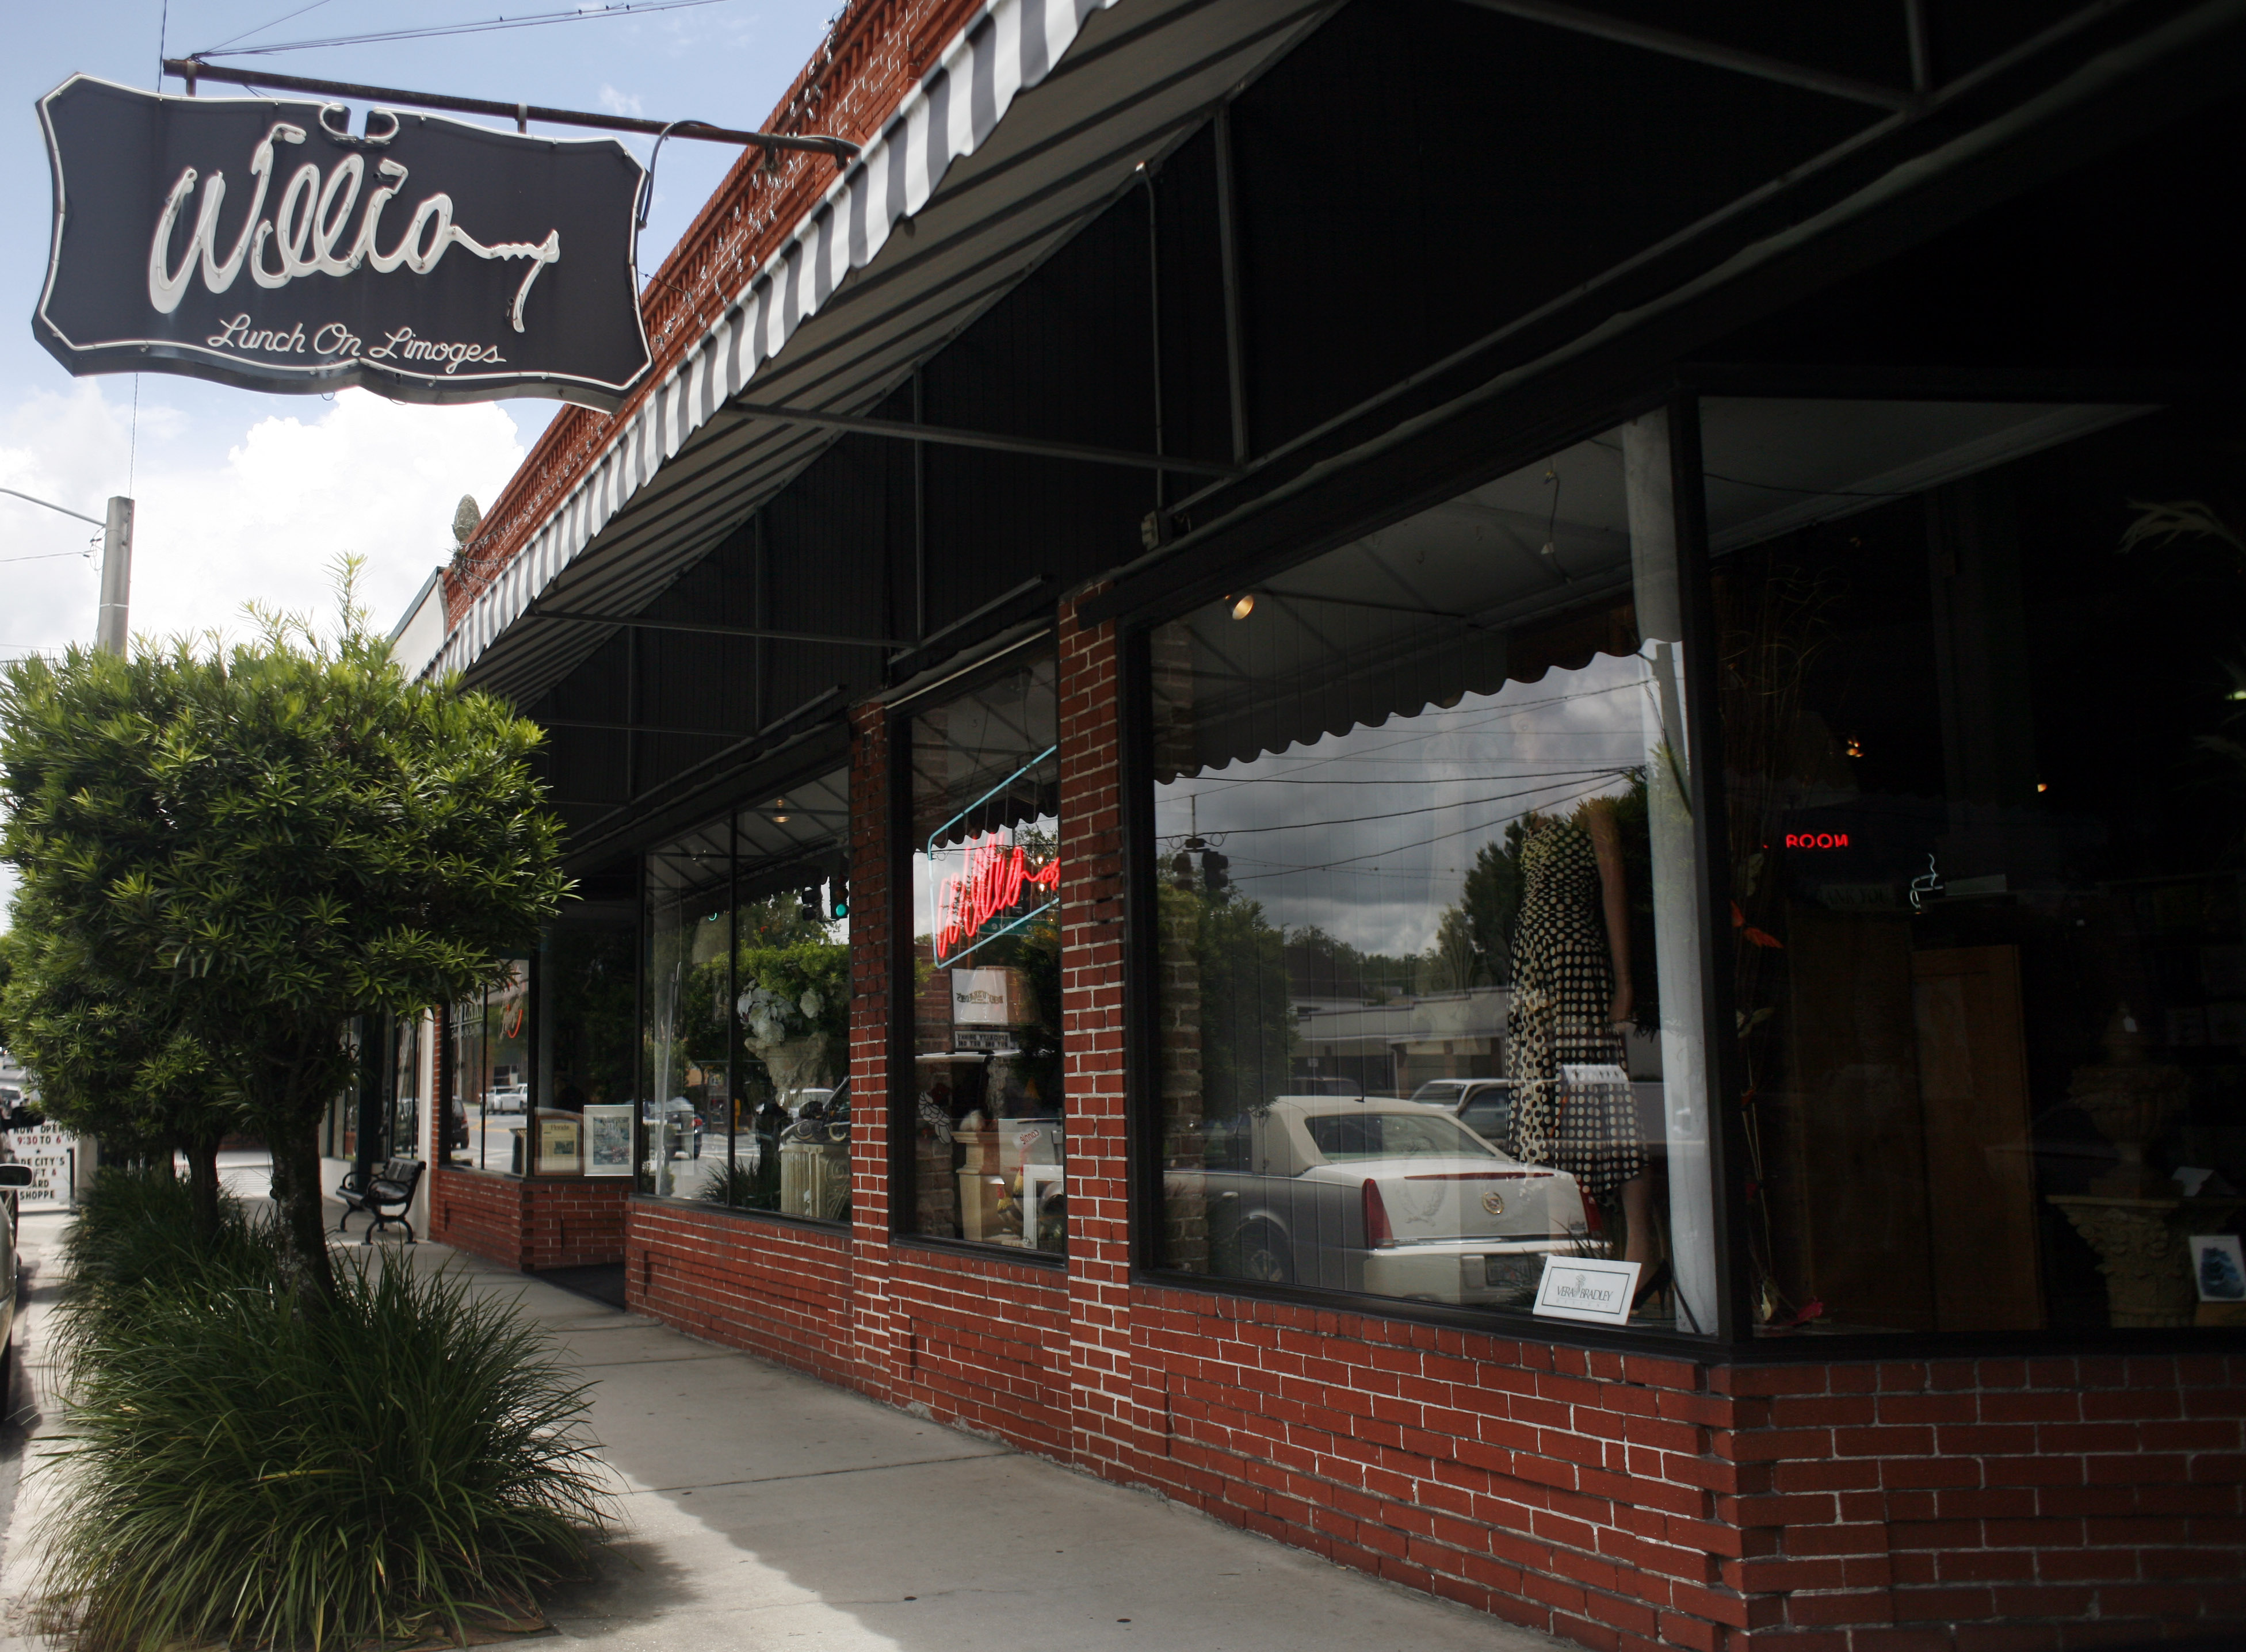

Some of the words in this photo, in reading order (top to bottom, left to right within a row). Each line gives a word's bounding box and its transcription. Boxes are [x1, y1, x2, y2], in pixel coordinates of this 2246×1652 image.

[208, 313, 305, 354] Lunch
[314, 322, 362, 357] On
[368, 327, 507, 374] Limoges
[17, 1136, 37, 1145] 9:30
[40, 1135, 51, 1144] TO
[56, 1135, 62, 1144] 6
[35, 1156, 65, 1166] CITY'S
[32, 1179, 49, 1188] ARD
[20, 1190, 55, 1200] SHOPPE
[1557, 1286, 1574, 1298] VERA
[1579, 1288, 1614, 1301] BRADLEY
